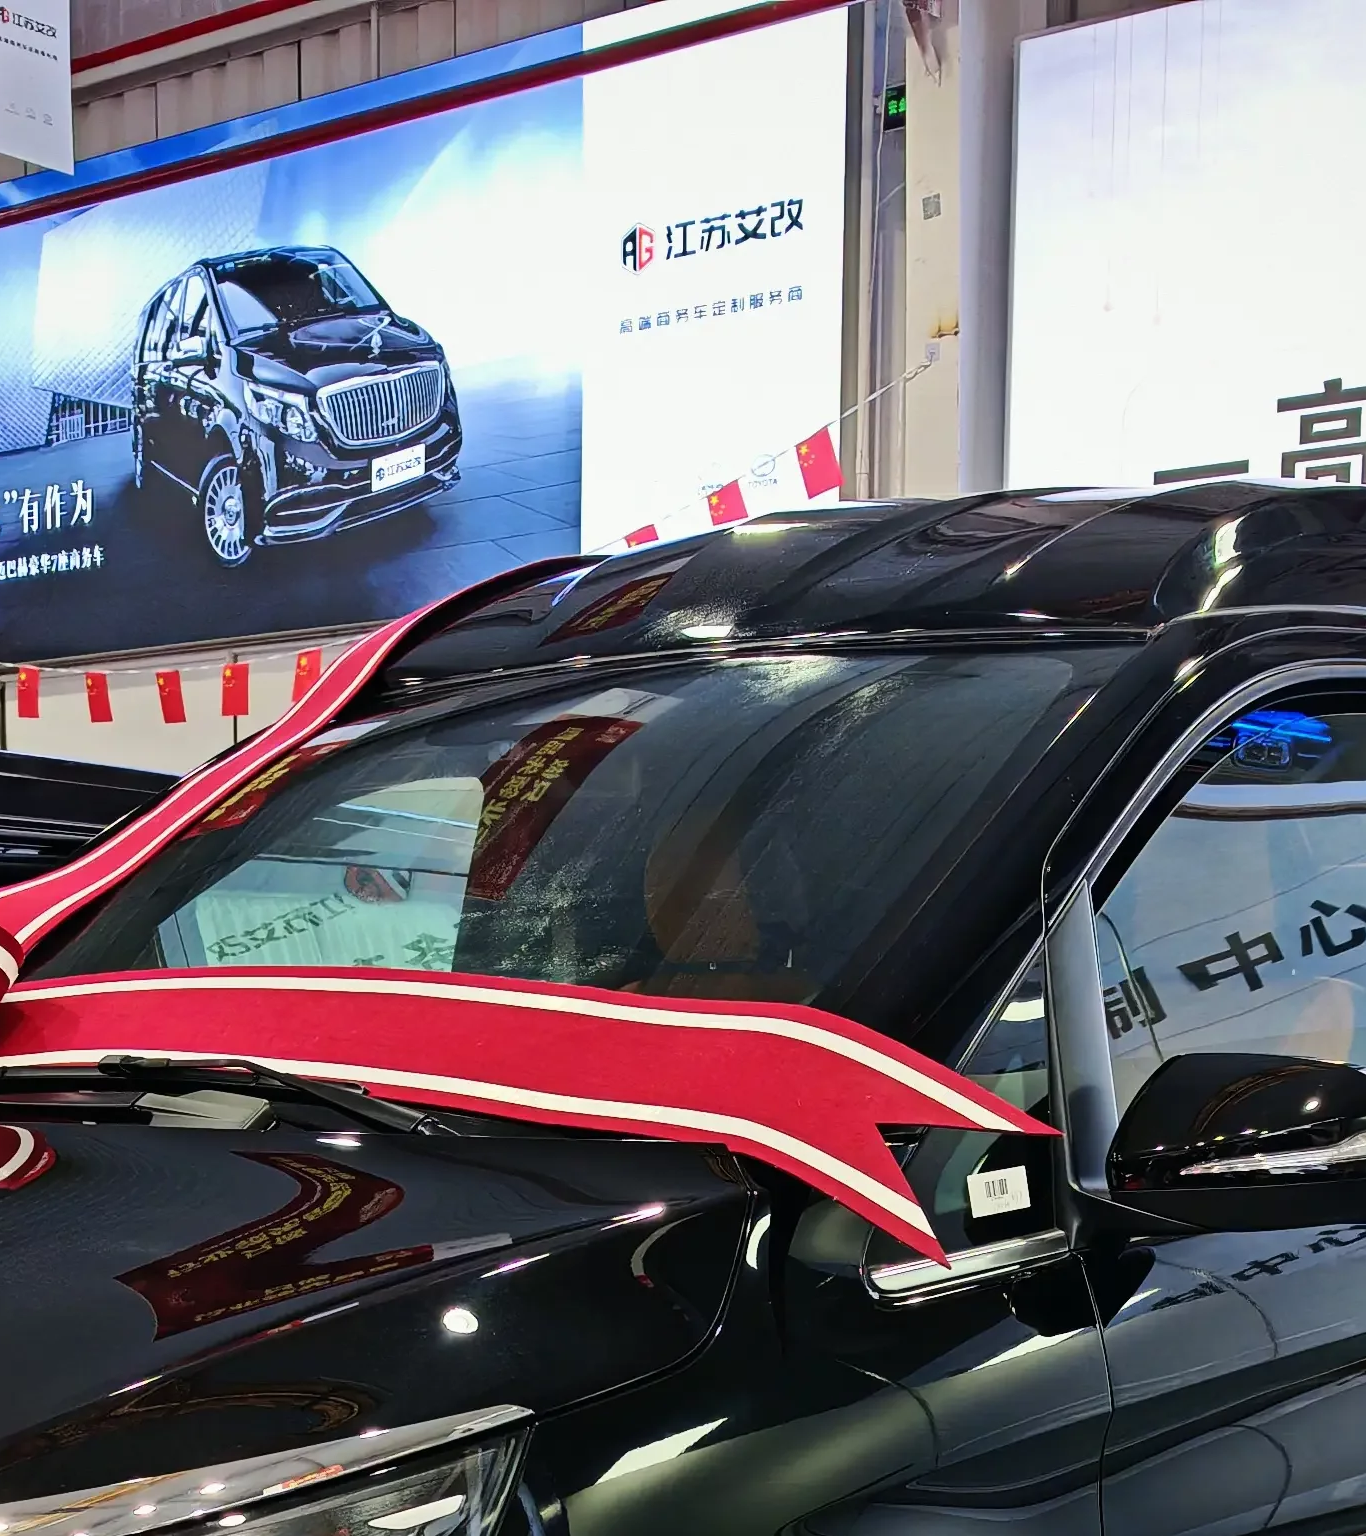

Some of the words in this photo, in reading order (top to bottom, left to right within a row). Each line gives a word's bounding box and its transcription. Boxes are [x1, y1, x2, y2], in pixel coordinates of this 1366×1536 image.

[666, 198, 804, 260] 江苏艾改
[620, 285, 803, 334] 高端商务车定制服务商
[748, 479, 778, 488] TOYOTA
